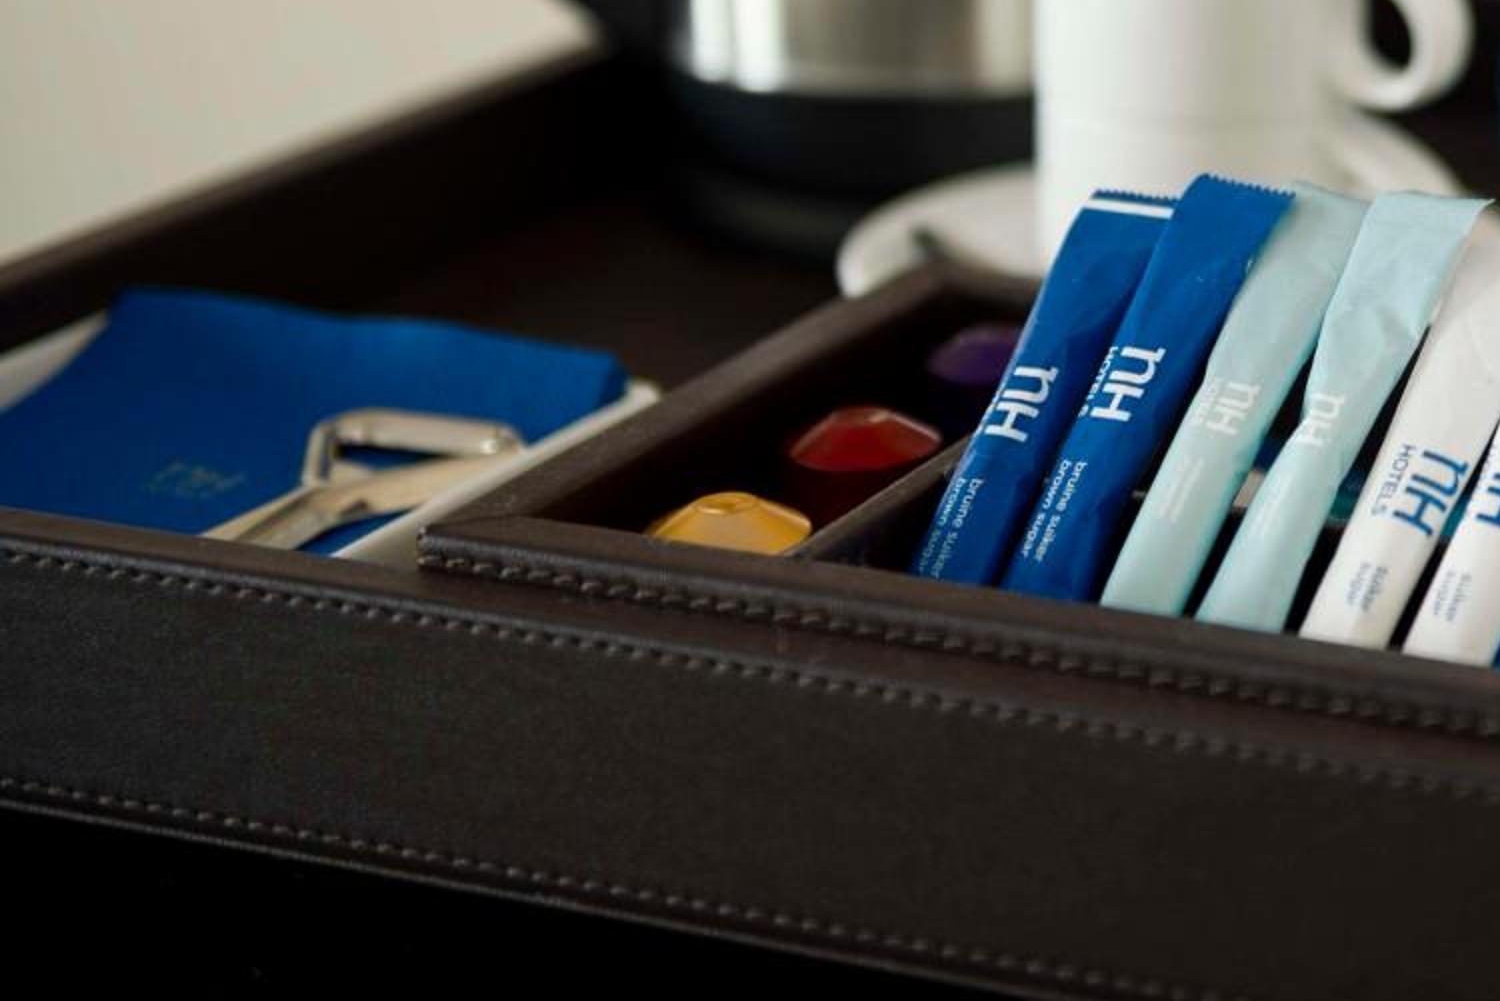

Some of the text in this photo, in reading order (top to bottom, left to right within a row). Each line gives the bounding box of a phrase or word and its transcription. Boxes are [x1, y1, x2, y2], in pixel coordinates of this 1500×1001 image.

[931, 479, 984, 580] bruine suiker
[938, 478, 966, 527] brown
[1022, 459, 1069, 558] brown sugar
[1036, 461, 1088, 562] bruine suiker
[1372, 444, 1417, 516] HOTELS
